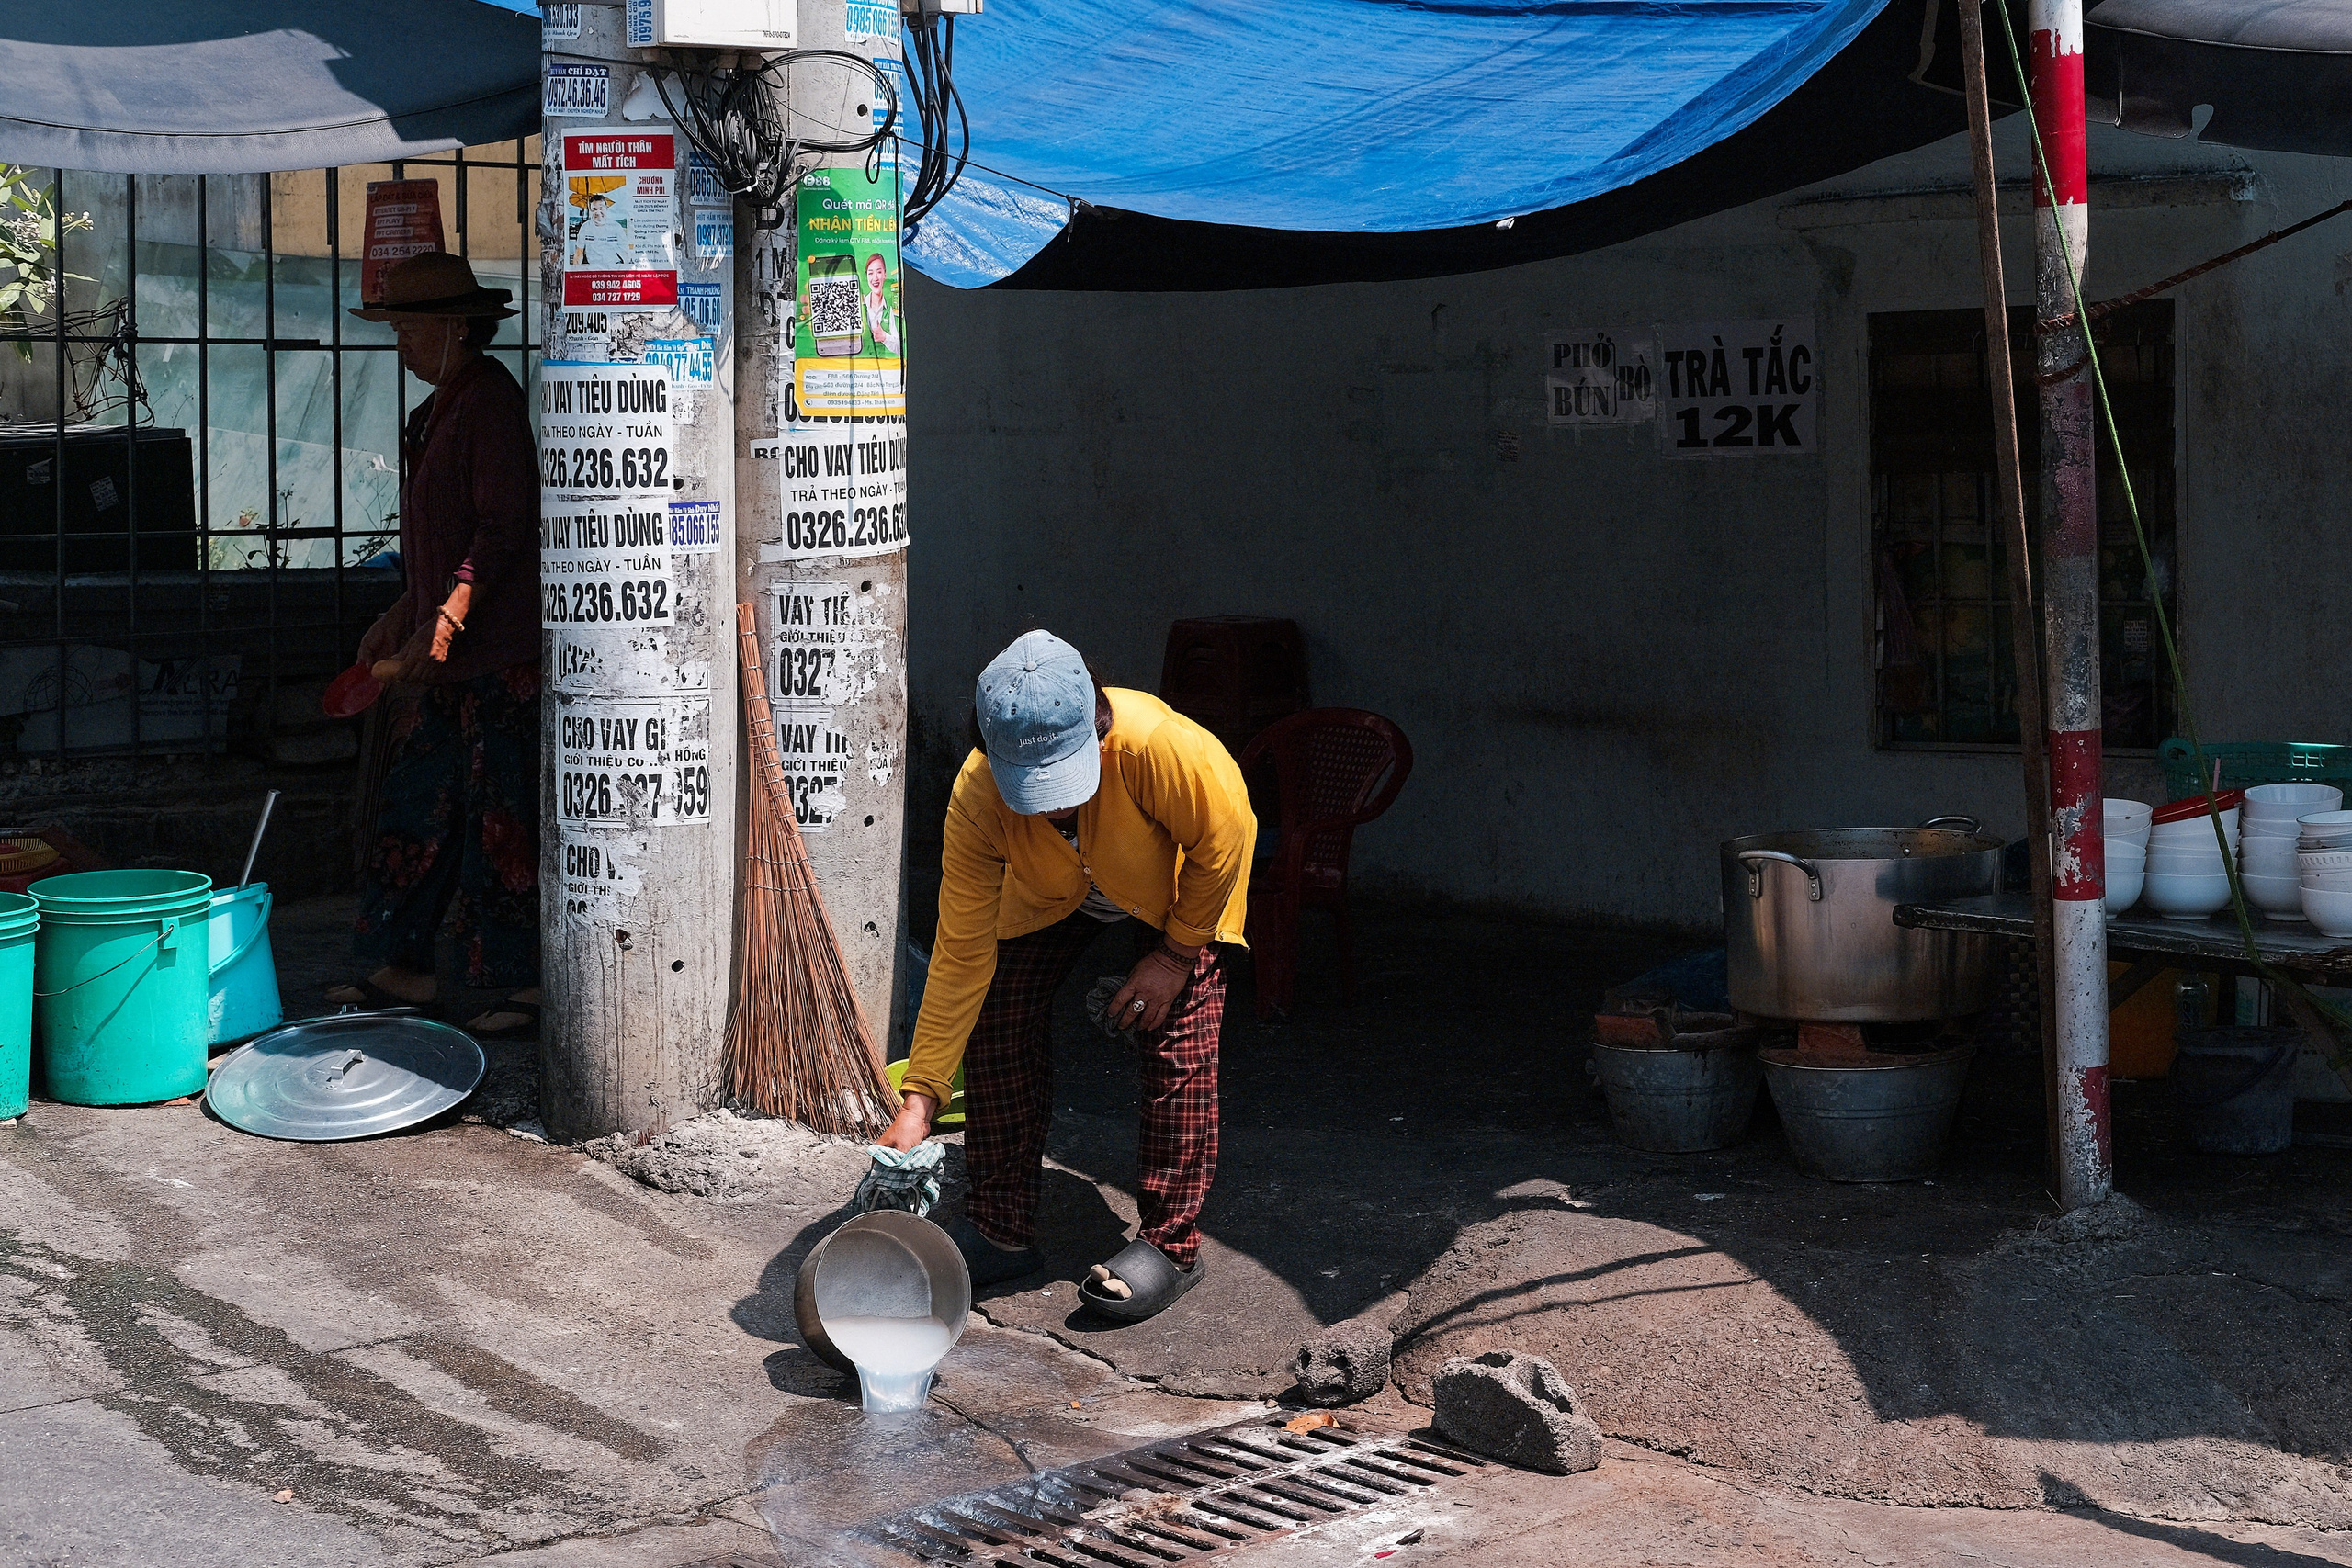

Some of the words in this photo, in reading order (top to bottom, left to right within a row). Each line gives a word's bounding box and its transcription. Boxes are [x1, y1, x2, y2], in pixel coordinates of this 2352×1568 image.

[846, 5, 872, 34] 0985
[547, 78, 606, 108] 0972.46.36.46
[578, 141, 594, 154] TÌM
[595, 140, 625, 153] NGƯỜI
[627, 140, 652, 153] THÂN
[592, 154, 613, 168] MẤT
[615, 154, 637, 168] TÍCH
[636, 186, 653, 195] MINH
[654, 186, 665, 195] PHI
[803, 175, 831, 186] F88
[822, 198, 853, 209] Quét
[855, 199, 872, 209] mã
[874, 199, 887, 209] QR
[808, 214, 852, 234] NHẬN
[371, 247, 390, 257] 034
[391, 246, 411, 256] 254
[591, 280, 605, 289] 039
[606, 280, 621, 289] 942
[622, 279, 641, 289] 4605
[686, 287, 704, 295] THANH
[592, 292, 605, 301] 034
[607, 292, 621, 301] 727
[623, 291, 641, 301] 1729
[1552, 332, 1611, 368] PHỞ
[1665, 335, 1732, 399] TRÀ
[1742, 324, 1812, 396] TẮC
[1617, 354, 1651, 402] BÒ
[553, 381, 573, 414] VAY
[577, 373, 612, 414] TIÊU
[617, 373, 667, 414] DÙNG
[1553, 377, 1610, 417] BÚN
[551, 425, 575, 438] THEO
[579, 422, 614, 438] NGÀY
[626, 420, 663, 438] TUẦN
[1675, 403, 1802, 449] 12K
[784, 445, 819, 479] CHO
[823, 443, 854, 477] VAY
[857, 434, 887, 475] TIÊU
[790, 484, 818, 502] TRẢ
[821, 487, 856, 501] THEO
[859, 481, 888, 499] NGÀY
[695, 504, 707, 514] Duy
[552, 516, 571, 550] VAY
[574, 508, 609, 549] TIÊU
[615, 507, 664, 548] DÙNG
[669, 514, 720, 546] 85.066.155
[551, 560, 574, 574] THEO
[577, 557, 612, 573] NGÀY
[624, 553, 662, 571] TUẦN
[779, 594, 815, 626] VAY
[562, 715, 594, 750] CHO
[600, 718, 639, 750] VAY
[781, 723, 818, 754] VAY
[1036, 734, 1048, 742] do
[564, 752, 583, 765] GIỚI
[809, 757, 847, 773] THIỆU
[567, 843, 600, 879] CHO
[568, 881, 588, 894] GIỚI
